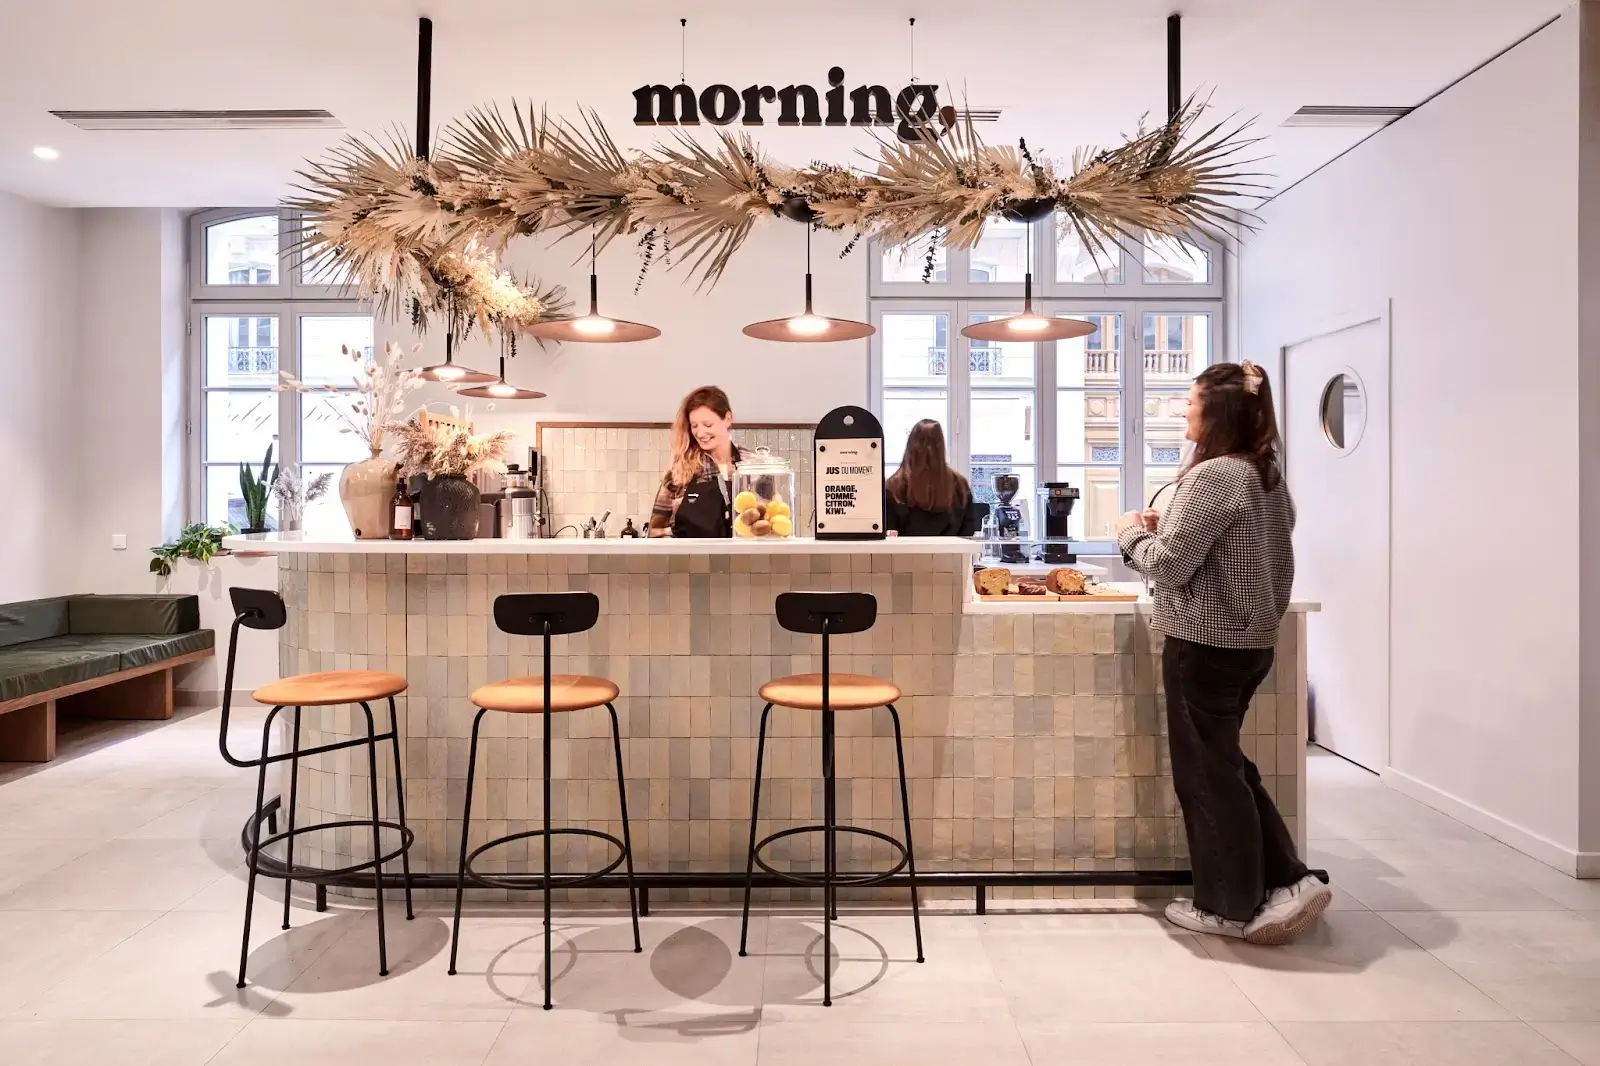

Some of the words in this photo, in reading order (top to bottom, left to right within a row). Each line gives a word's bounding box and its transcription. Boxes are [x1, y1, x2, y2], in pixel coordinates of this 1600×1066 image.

[826, 467, 840, 475] JUS
[850, 466, 873, 475] MOMENT
[825, 485, 858, 493] ORANGE,
